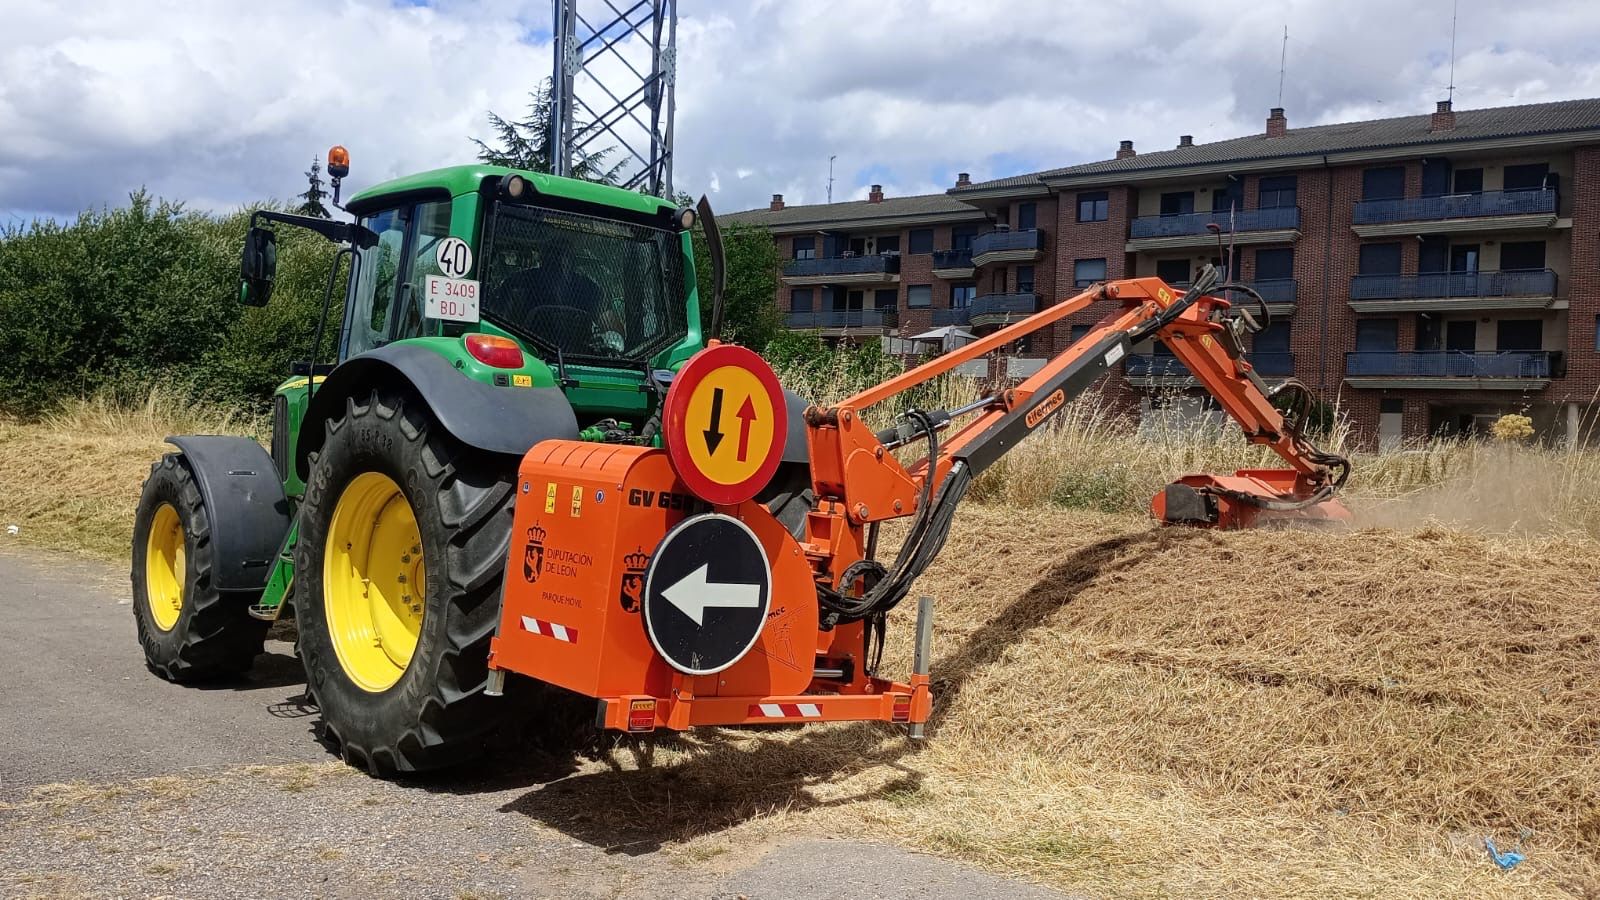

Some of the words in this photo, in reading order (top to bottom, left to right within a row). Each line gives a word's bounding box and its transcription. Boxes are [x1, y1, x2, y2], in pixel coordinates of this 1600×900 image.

[440, 241, 467, 275] 40
[431, 280, 439, 295] E
[445, 282, 475, 299] 3409
[440, 300, 465, 317] BDJ
[1026, 392, 1063, 425] tifermec
[629, 488, 655, 508] GV
[545, 561, 556, 574] DE
[542, 591, 564, 605] PARQUE
